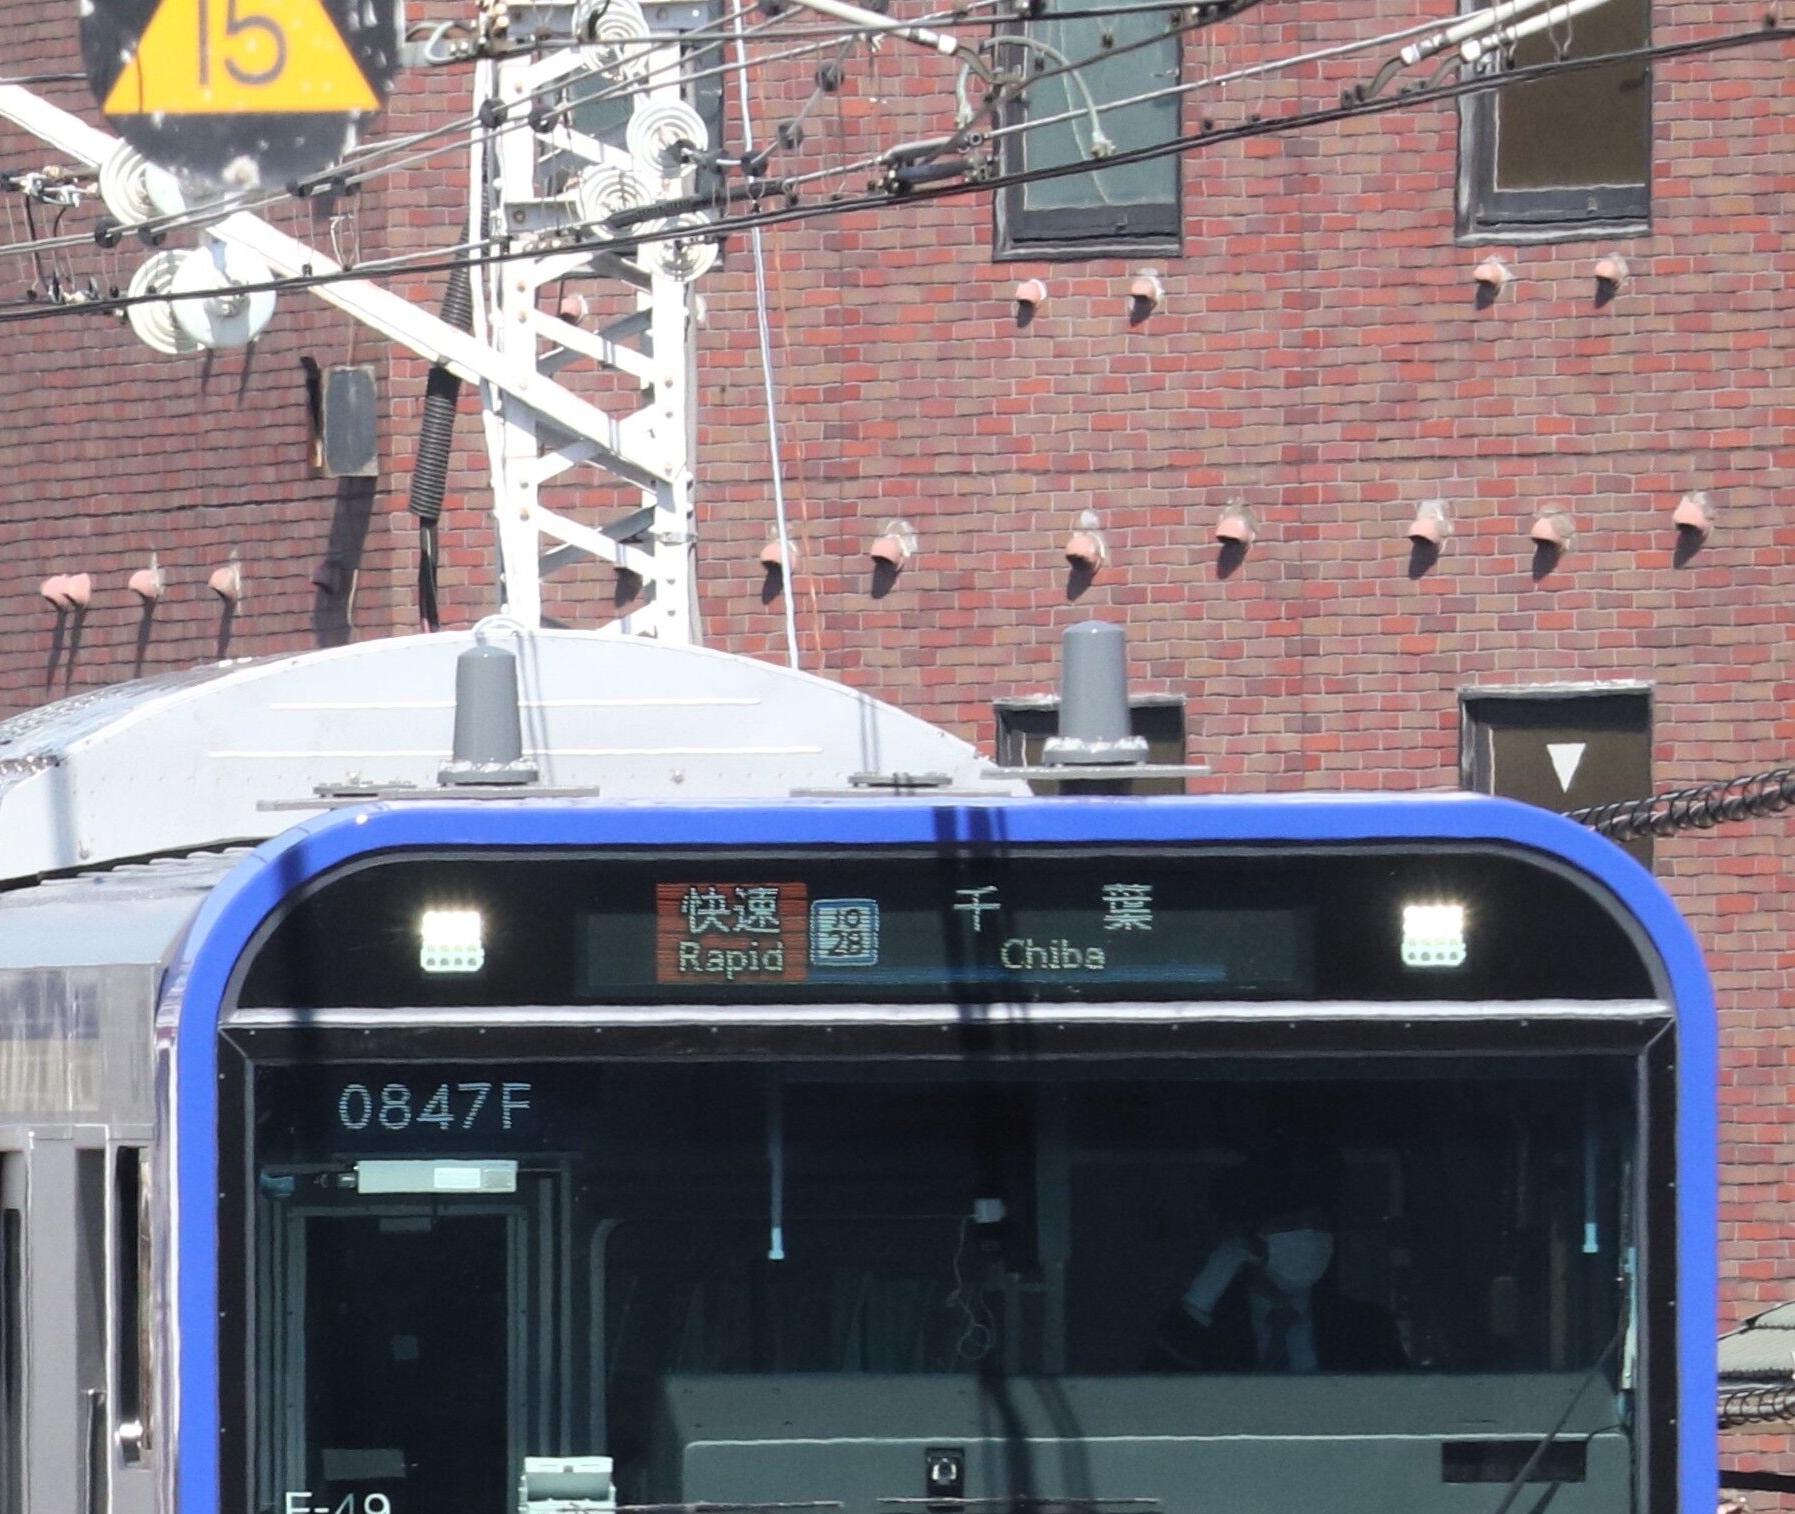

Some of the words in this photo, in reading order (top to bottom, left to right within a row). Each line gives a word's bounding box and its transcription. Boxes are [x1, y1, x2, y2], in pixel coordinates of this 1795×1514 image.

[198, 0, 287, 86] 15
[681, 886, 781, 934] 快速
[679, 941, 784, 980] Rapid
[827, 930, 863, 956] 28
[1000, 938, 1105, 969] Chiba
[338, 1082, 532, 1130] 0847F
